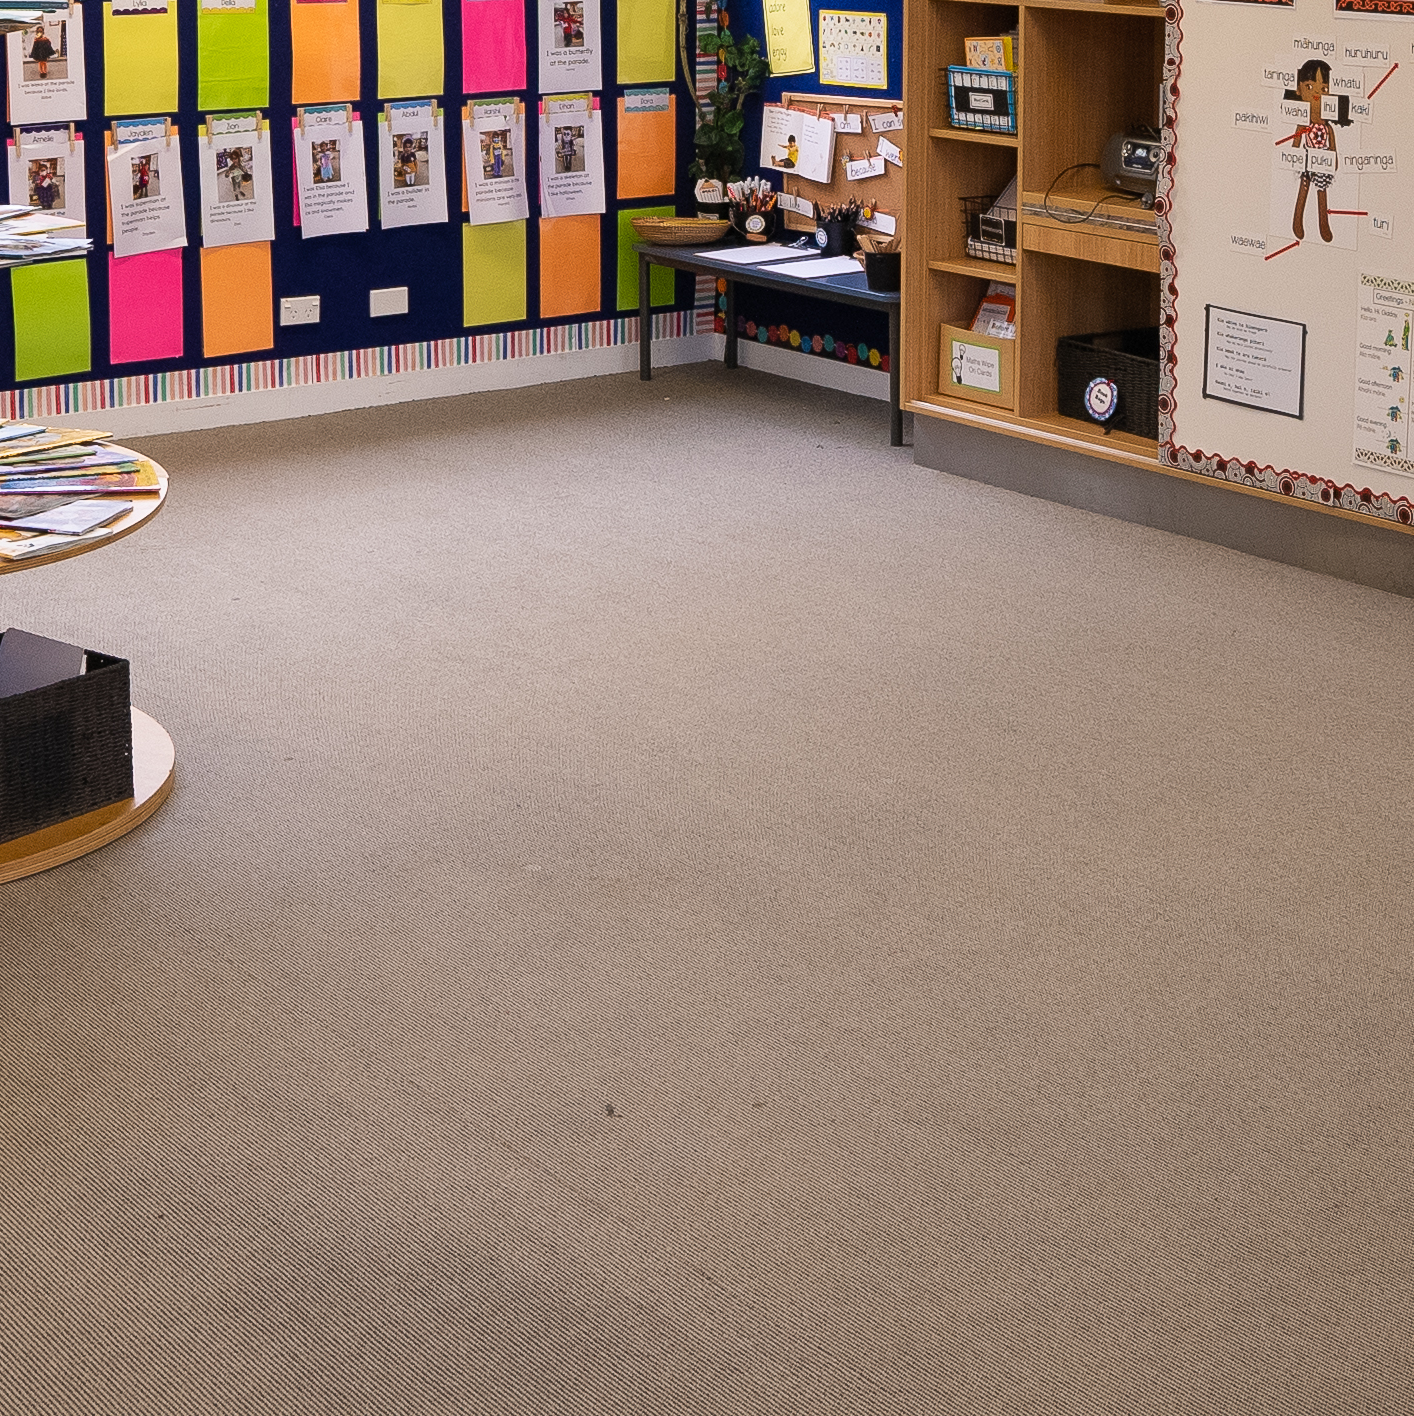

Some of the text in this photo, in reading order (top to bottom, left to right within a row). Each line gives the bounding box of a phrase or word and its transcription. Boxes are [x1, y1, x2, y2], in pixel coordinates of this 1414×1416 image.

[1293, 37, 1334, 56] māhunga
[1345, 47, 1388, 60] huruhuru
[1264, 69, 1295, 87] taringa
[1333, 77, 1361, 89] whatu
[1284, 107, 1308, 118] waha
[226, 121, 240, 131] Zion
[32, 135, 54, 143] Amelie
[128, 127, 154, 140] Jayden
[1311, 154, 1333, 168] puku
[1344, 153, 1394, 171] ringaringa
[1373, 217, 1390, 231] turi
